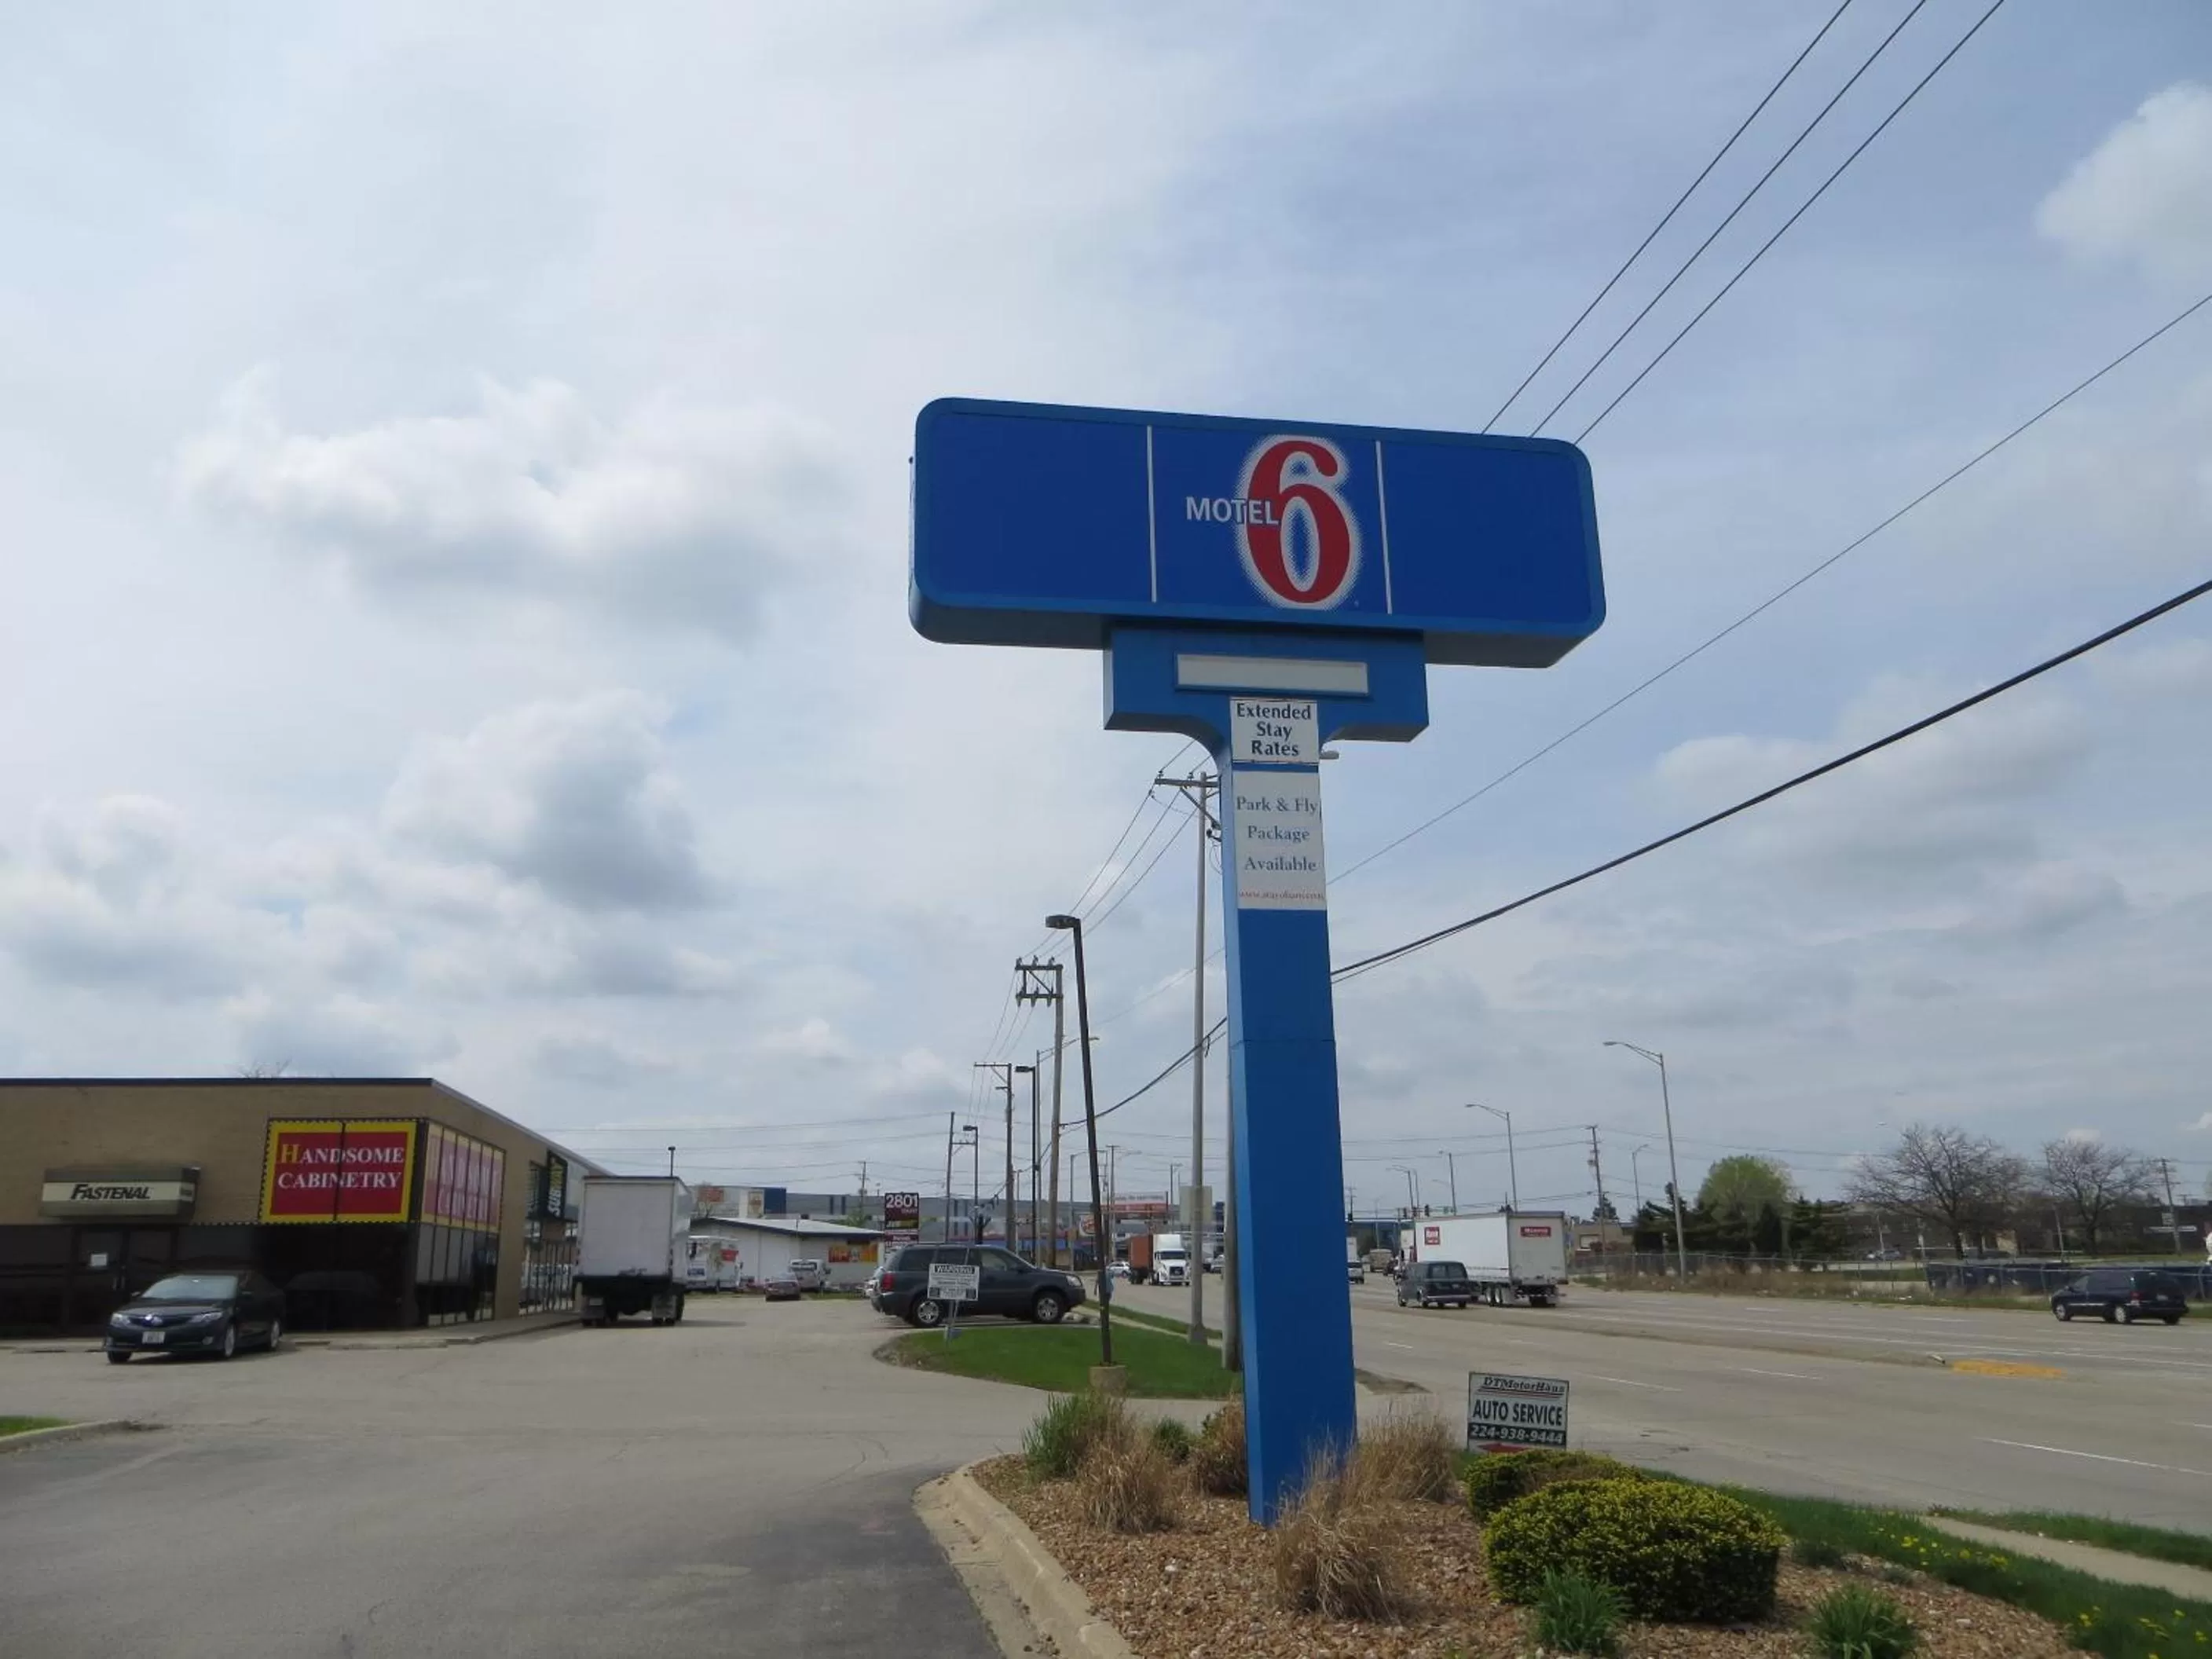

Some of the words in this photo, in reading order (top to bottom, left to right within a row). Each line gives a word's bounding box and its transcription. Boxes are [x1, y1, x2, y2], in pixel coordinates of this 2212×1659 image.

[1186, 496, 1279, 525] MOTEL
[1243, 437, 1354, 607] 6
[1236, 702, 1311, 720] Extended
[1257, 720, 1292, 740] Stay
[1251, 740, 1299, 756] Rates
[1236, 796, 1271, 811] Park
[1276, 797, 1290, 811] &
[1295, 797, 1318, 815] Fly
[1247, 825, 1310, 843] Package
[1244, 856, 1317, 872] Available
[280, 1144, 405, 1164] HANDSOME
[277, 1171, 402, 1188] CABINETRY
[69, 1184, 151, 1200] FASTENAL
[885, 1194, 918, 1208] 2801
[1473, 1399, 1508, 1421] AUTO
[1512, 1403, 1562, 1426] SERVICE
[1470, 1424, 1563, 1445] 224-938-9444
